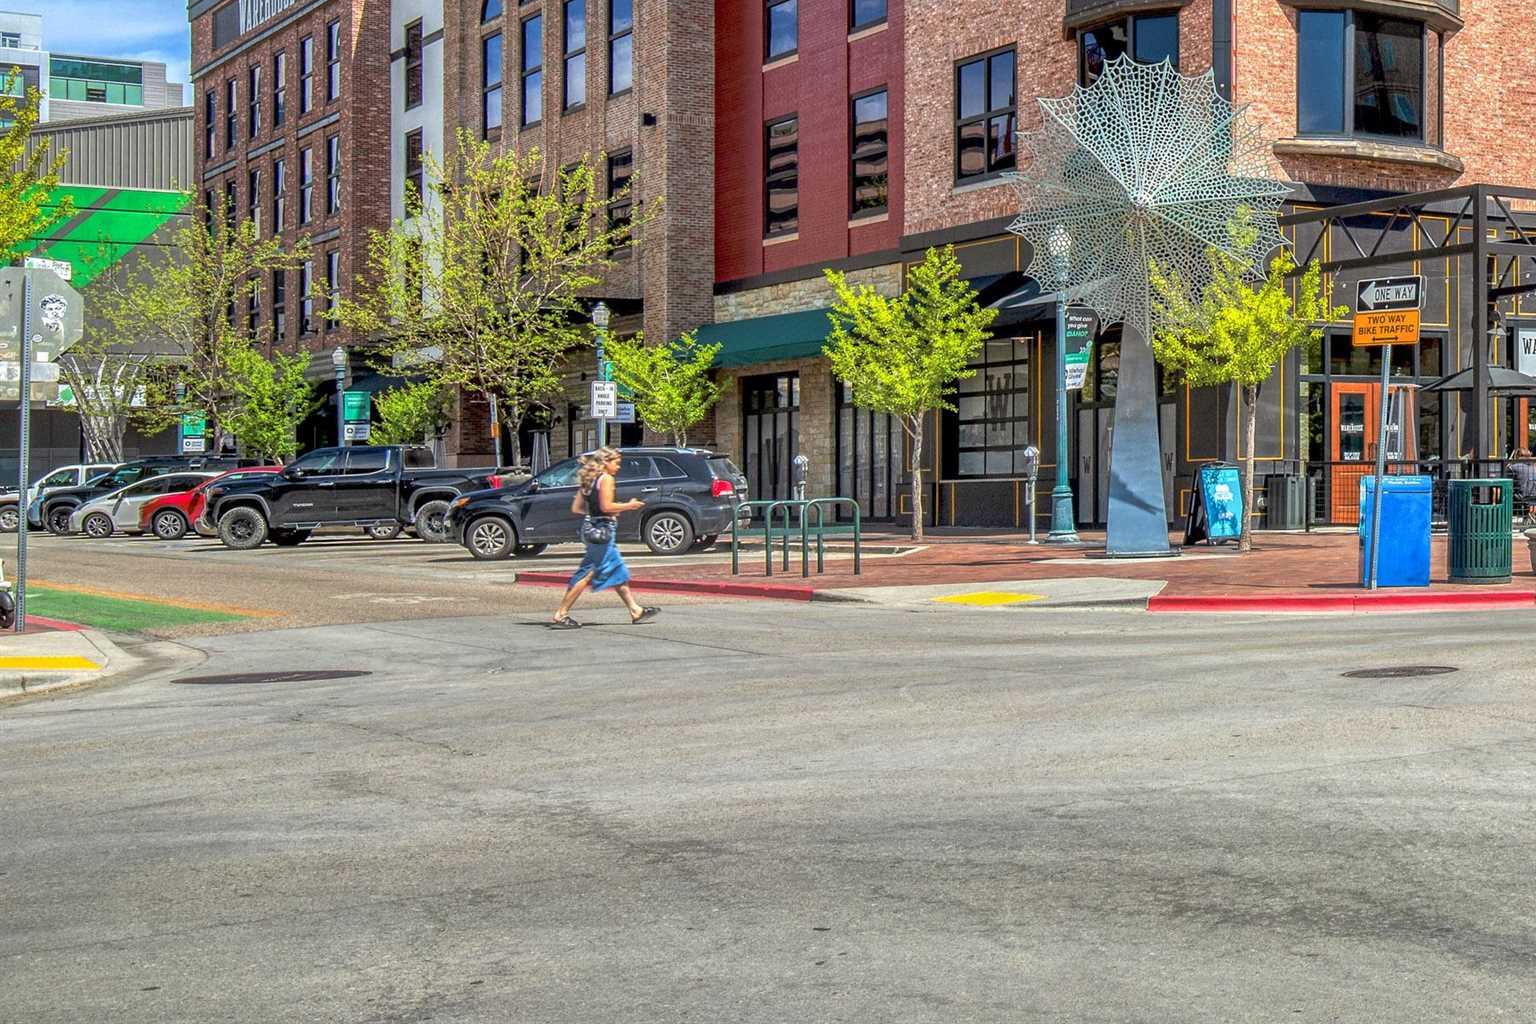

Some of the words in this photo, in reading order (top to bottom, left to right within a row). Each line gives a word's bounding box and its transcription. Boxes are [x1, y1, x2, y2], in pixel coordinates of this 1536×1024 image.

[1374, 288, 1391, 301] ONE
[1395, 286, 1414, 299] WAY
[1368, 315, 1385, 324] TWO
[1388, 314, 1406, 323] WAY
[1358, 326, 1376, 335] BIKE
[1380, 324, 1415, 334] TRAFFIC
